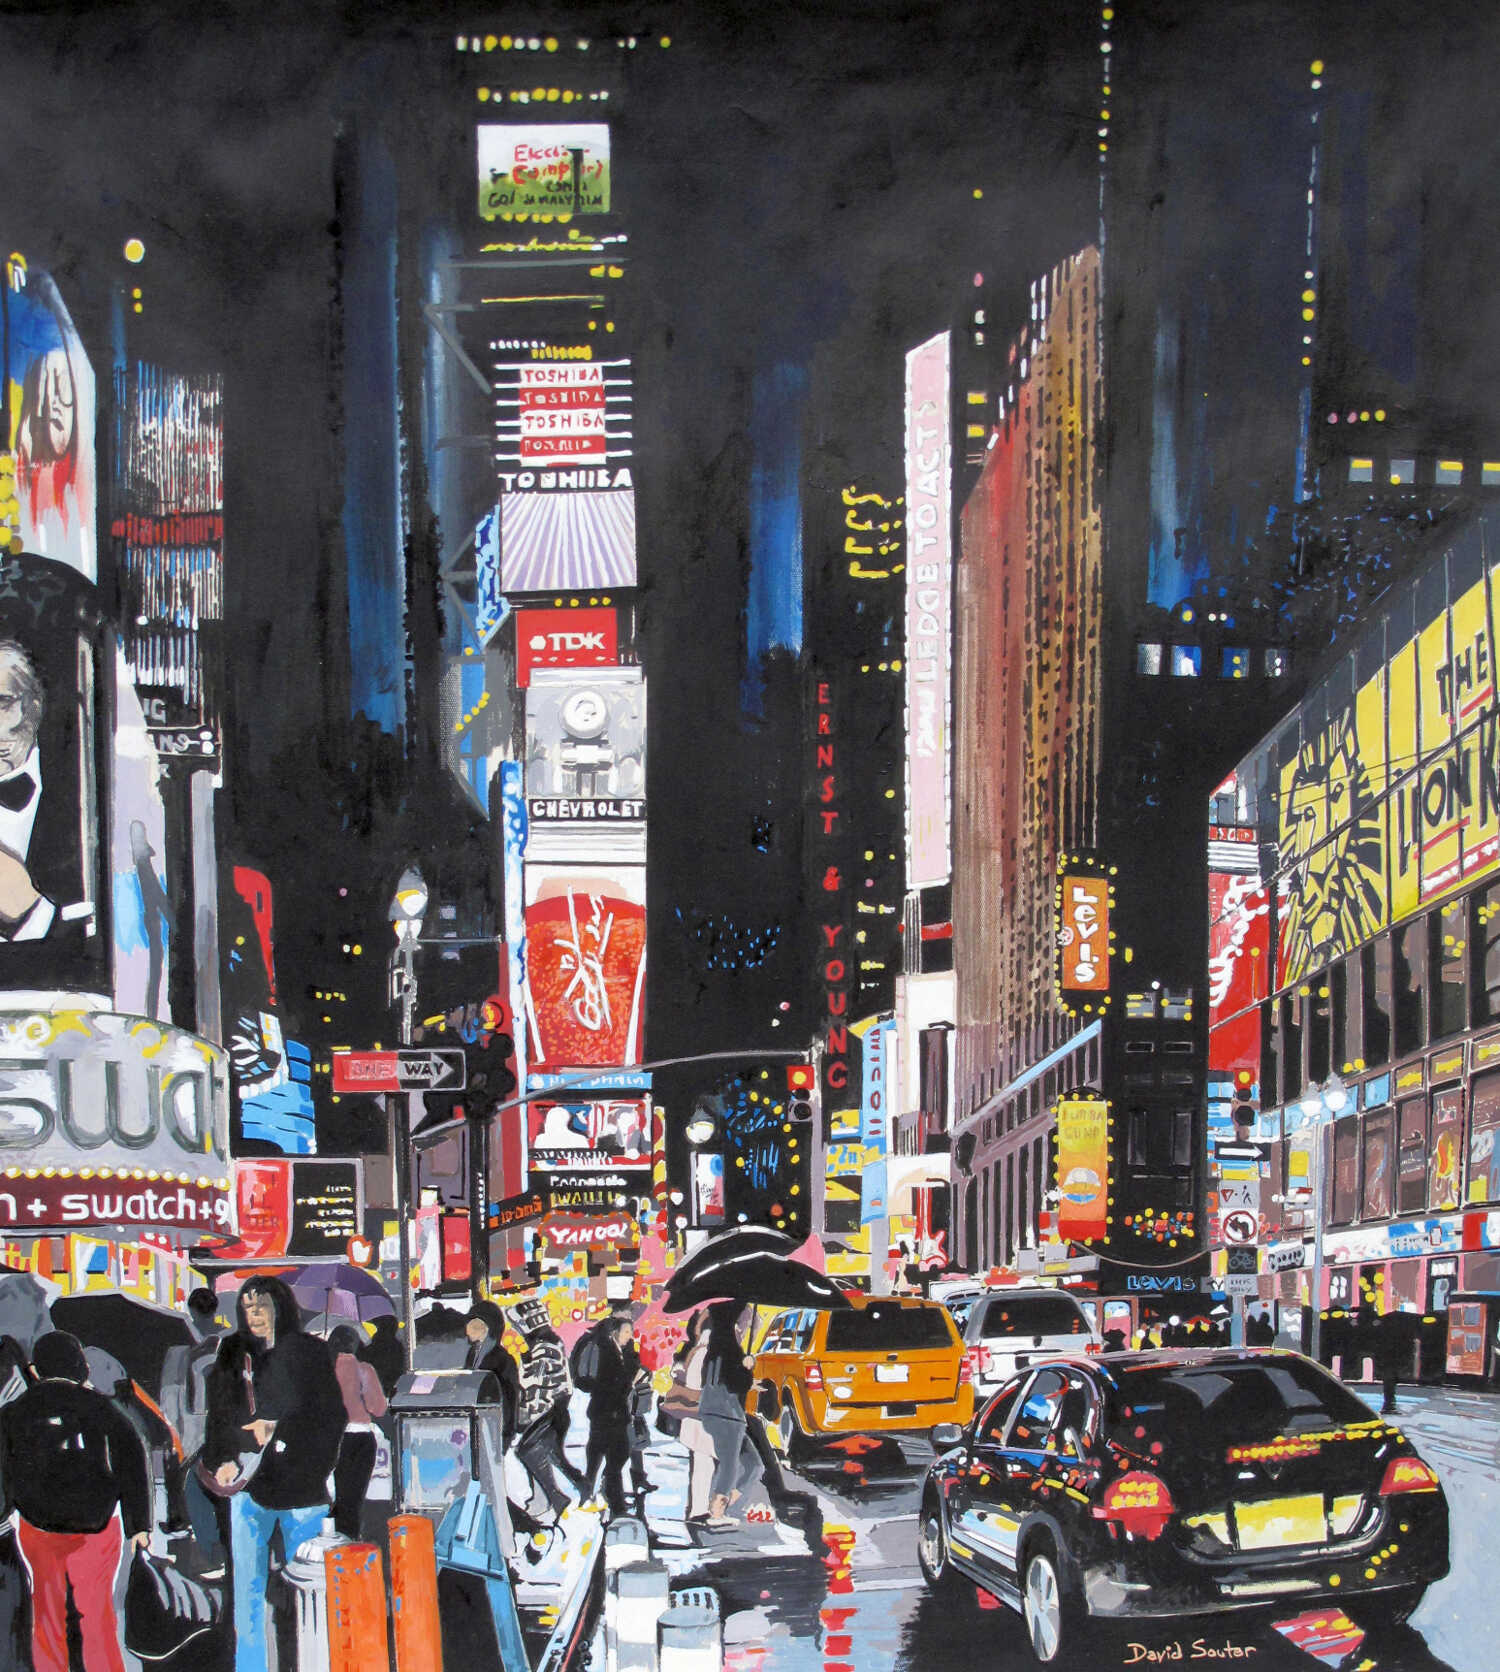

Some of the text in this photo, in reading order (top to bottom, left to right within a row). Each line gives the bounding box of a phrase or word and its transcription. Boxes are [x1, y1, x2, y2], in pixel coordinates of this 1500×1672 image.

[548, 632, 605, 651] TDK
[1436, 630, 1489, 716] THE
[818, 683, 837, 833] ERNST
[532, 801, 644, 818] CHEVROLET
[823, 867, 840, 891] &
[405, 1062, 444, 1076] WAY
[1123, 1642, 1183, 1663] David
